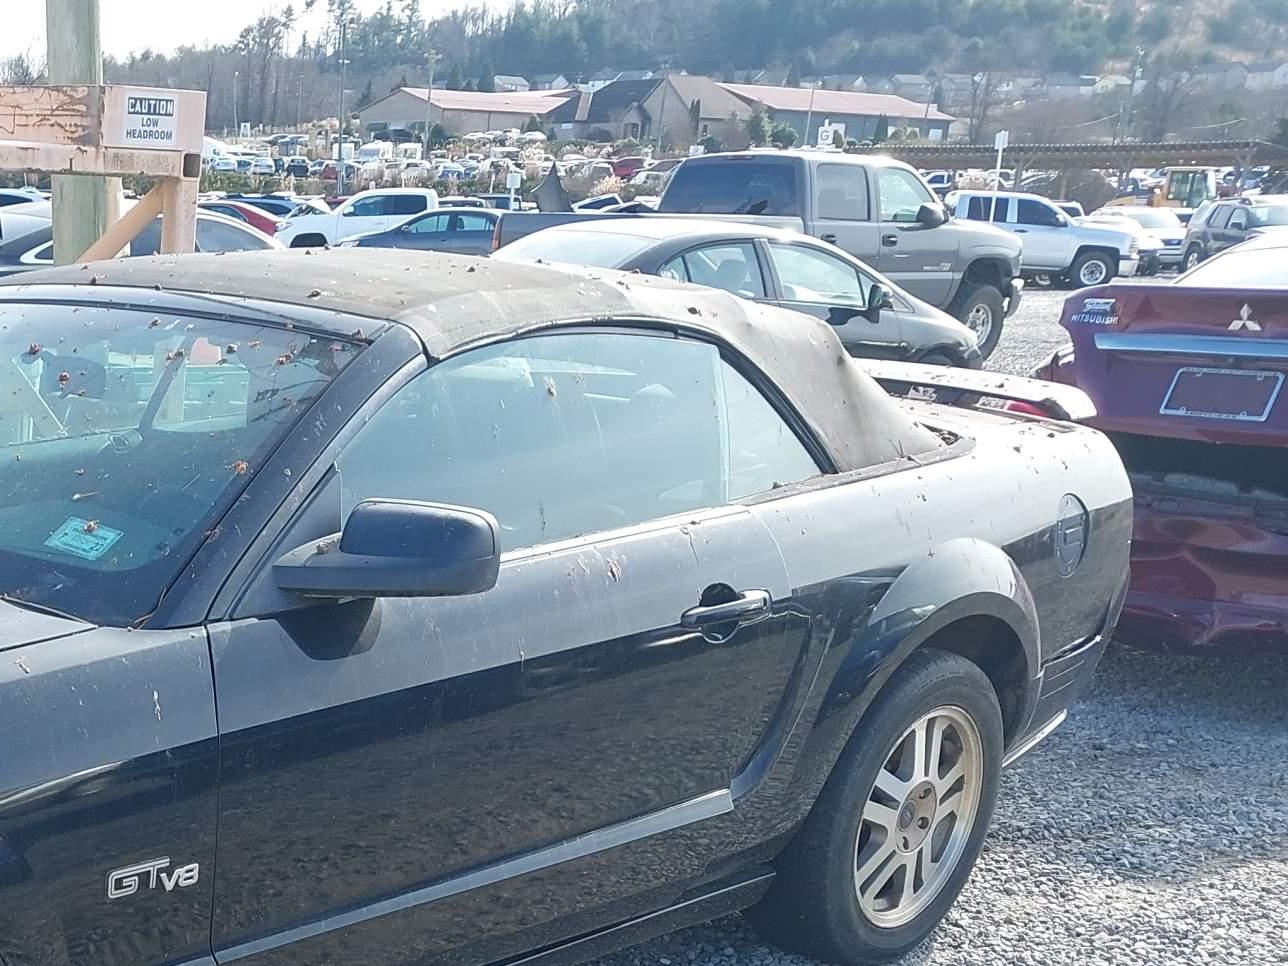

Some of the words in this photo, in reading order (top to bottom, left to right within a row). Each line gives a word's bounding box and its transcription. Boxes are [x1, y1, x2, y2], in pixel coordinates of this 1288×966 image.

[128, 98, 174, 115] CAUTION
[141, 117, 160, 128] LOW
[126, 129, 172, 141] HEADROOM
[820, 130, 830, 141] G
[1070, 313, 1119, 325] MITSUBISHI
